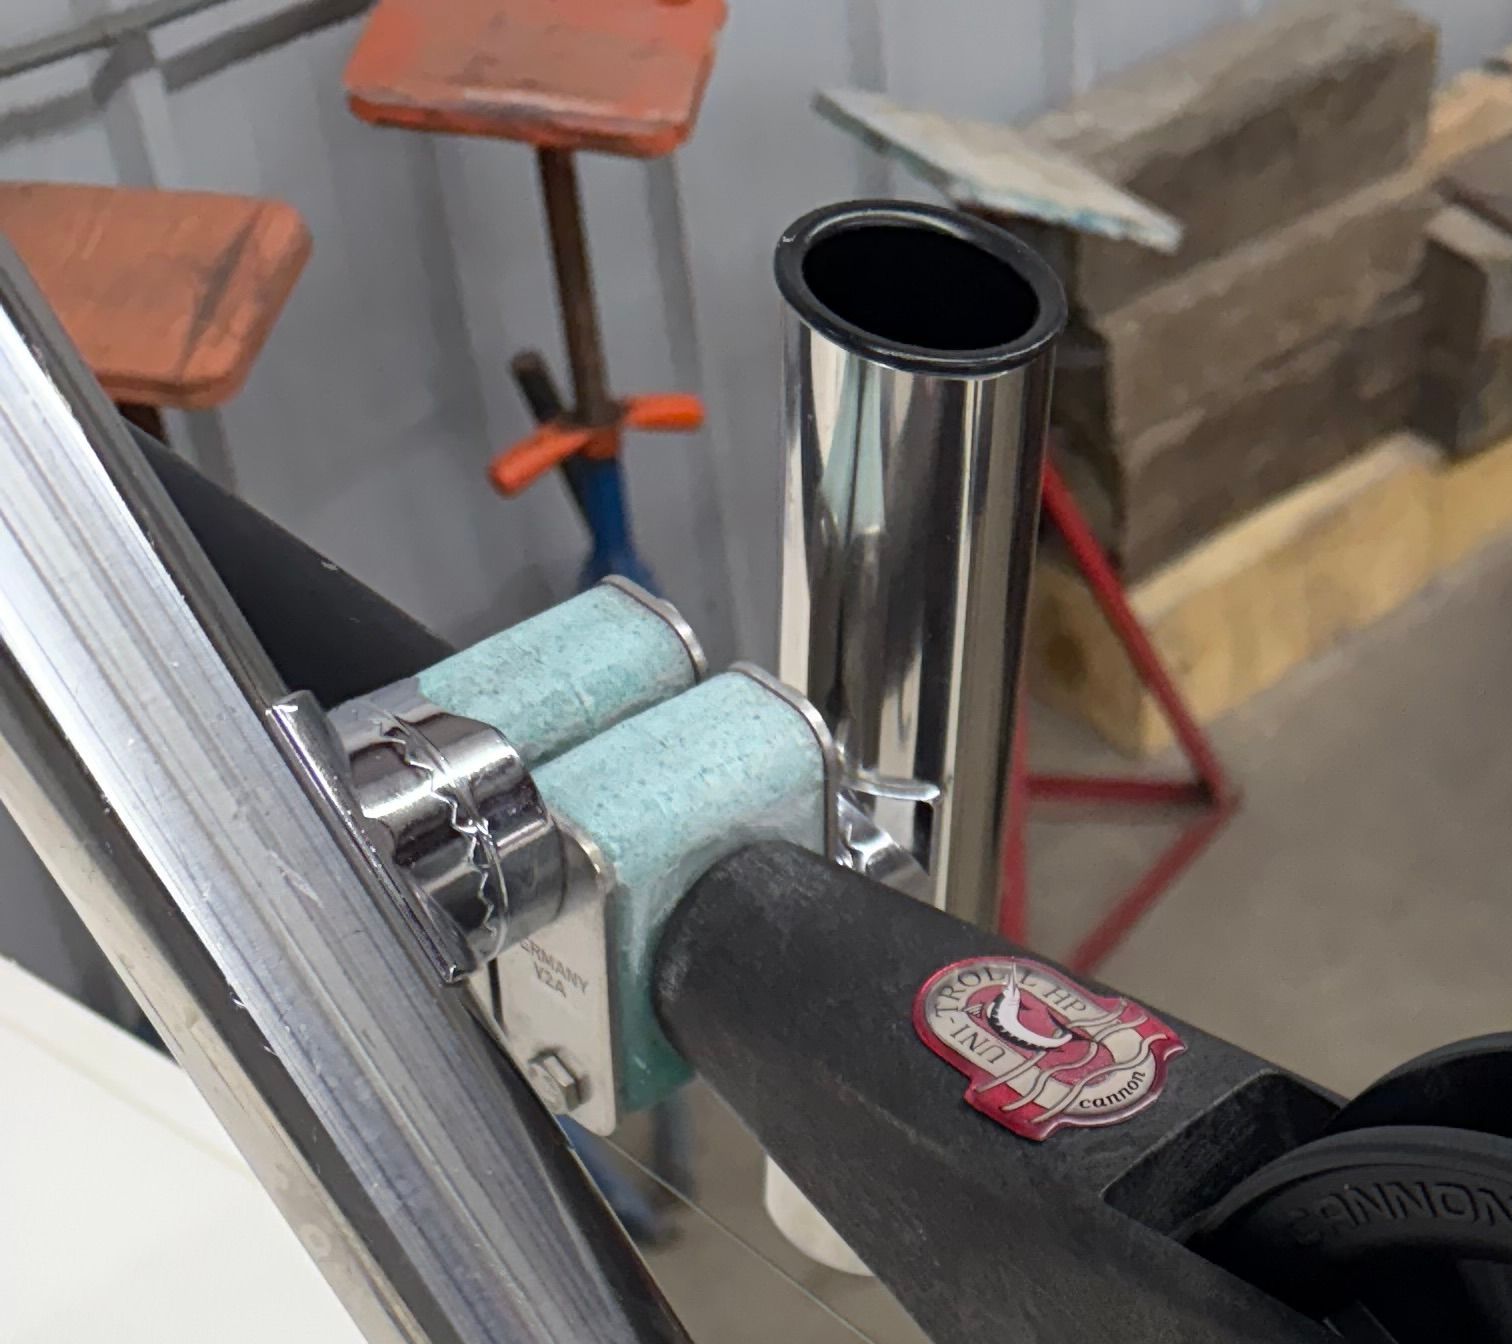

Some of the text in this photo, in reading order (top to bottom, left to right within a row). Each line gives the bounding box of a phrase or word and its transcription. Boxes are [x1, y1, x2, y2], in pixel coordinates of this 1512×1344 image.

[520, 938, 588, 994] ERMANY
[533, 961, 567, 998] V2A
[934, 966, 1087, 1064] UNI-TROLL HP
[1079, 1070, 1146, 1110] cannon
